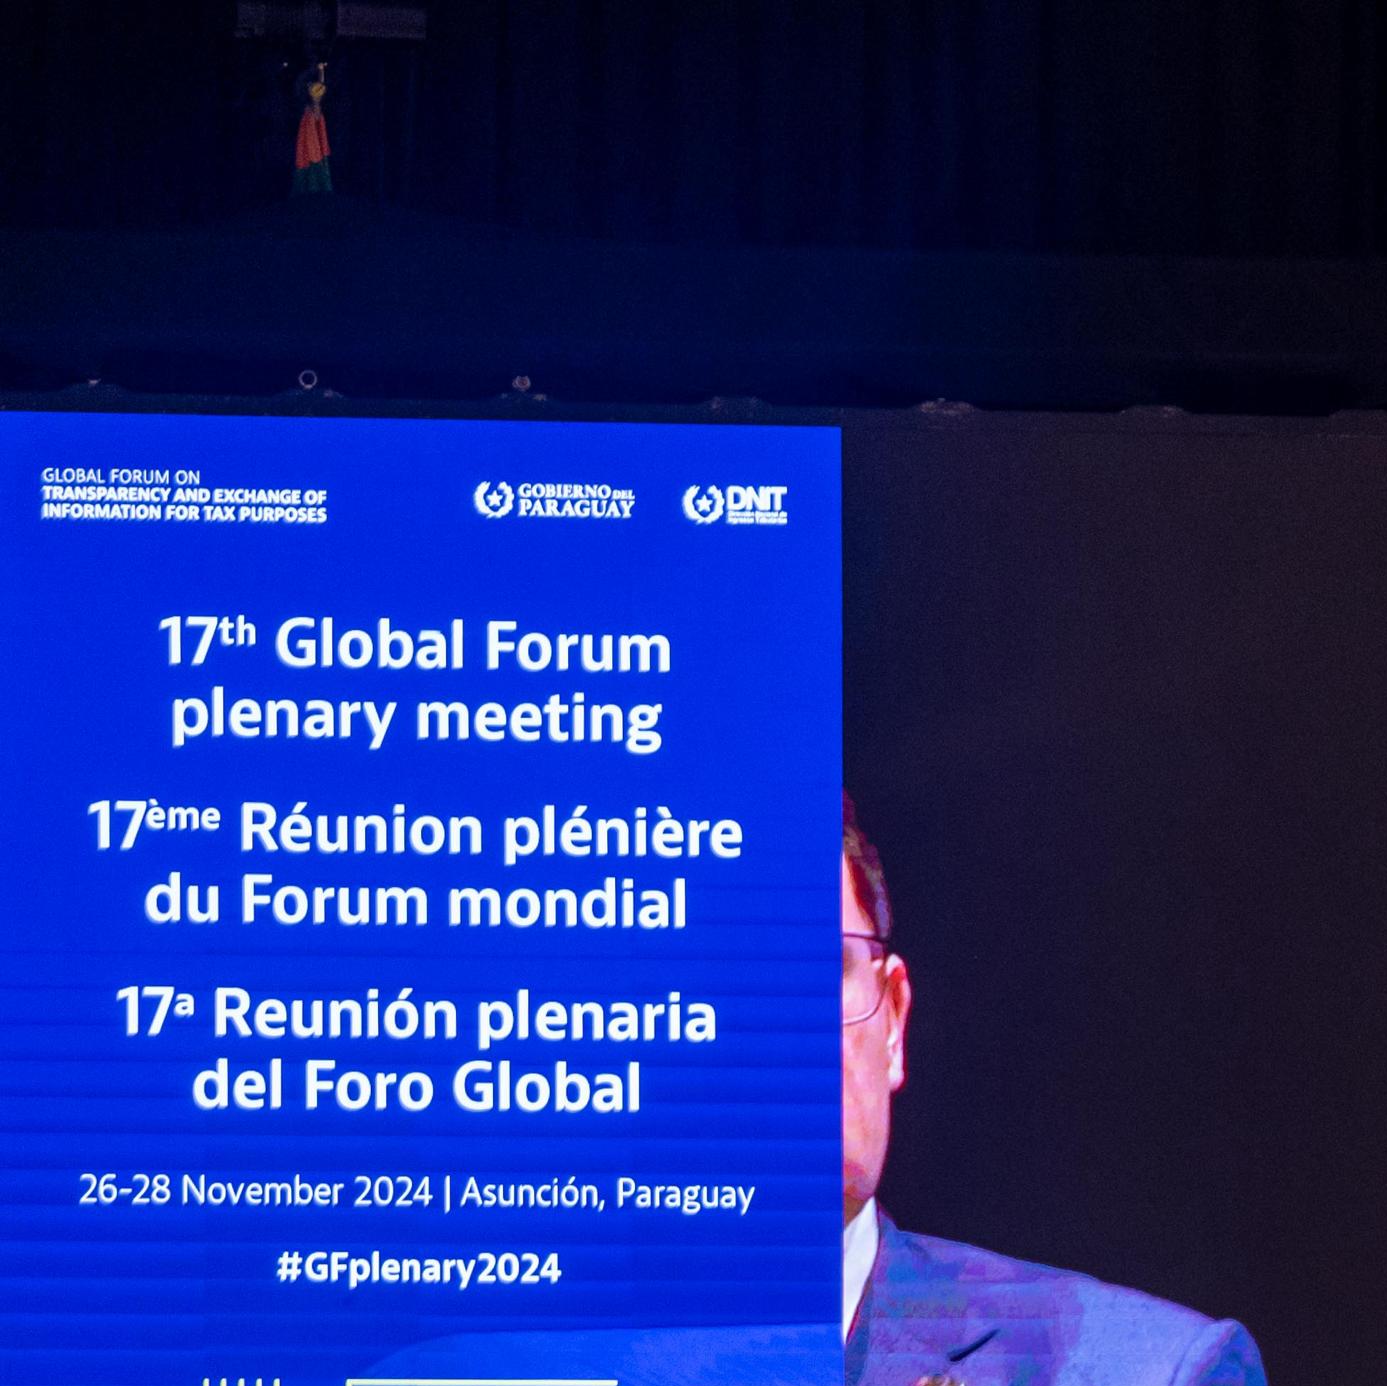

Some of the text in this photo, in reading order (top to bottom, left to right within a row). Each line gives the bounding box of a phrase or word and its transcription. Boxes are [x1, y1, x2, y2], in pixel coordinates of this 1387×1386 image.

[42, 468, 200, 485] GLOBAL FORUM ON
[42, 485, 327, 505] TRANSPARENCY AND EXCHANGE OF
[518, 483, 635, 499] GOBIERNO DEL
[42, 503, 327, 523] INFORMATION FOR TAX PURPOSES
[517, 500, 636, 518] PARAGUAY
[727, 486, 787, 511] DNIT
[160, 615, 670, 672] 17th Global Forum
[174, 687, 662, 753] plenary meeting
[242, 802, 481, 854] Réunion
[505, 805, 742, 864] plénière
[146, 872, 685, 928] du Forum mondial
[216, 988, 456, 1038] Reunión
[479, 990, 715, 1049] plenaria
[193, 1058, 639, 1112] del Foro Global
[80, 1174, 170, 1203] 26-28
[183, 1175, 344, 1204] November
[355, 1176, 432, 1205] 2024
[461, 1176, 604, 1210] Asunción,
[618, 1178, 754, 1214] Paraguay
[278, 1251, 561, 1288] #GFplenary2024
